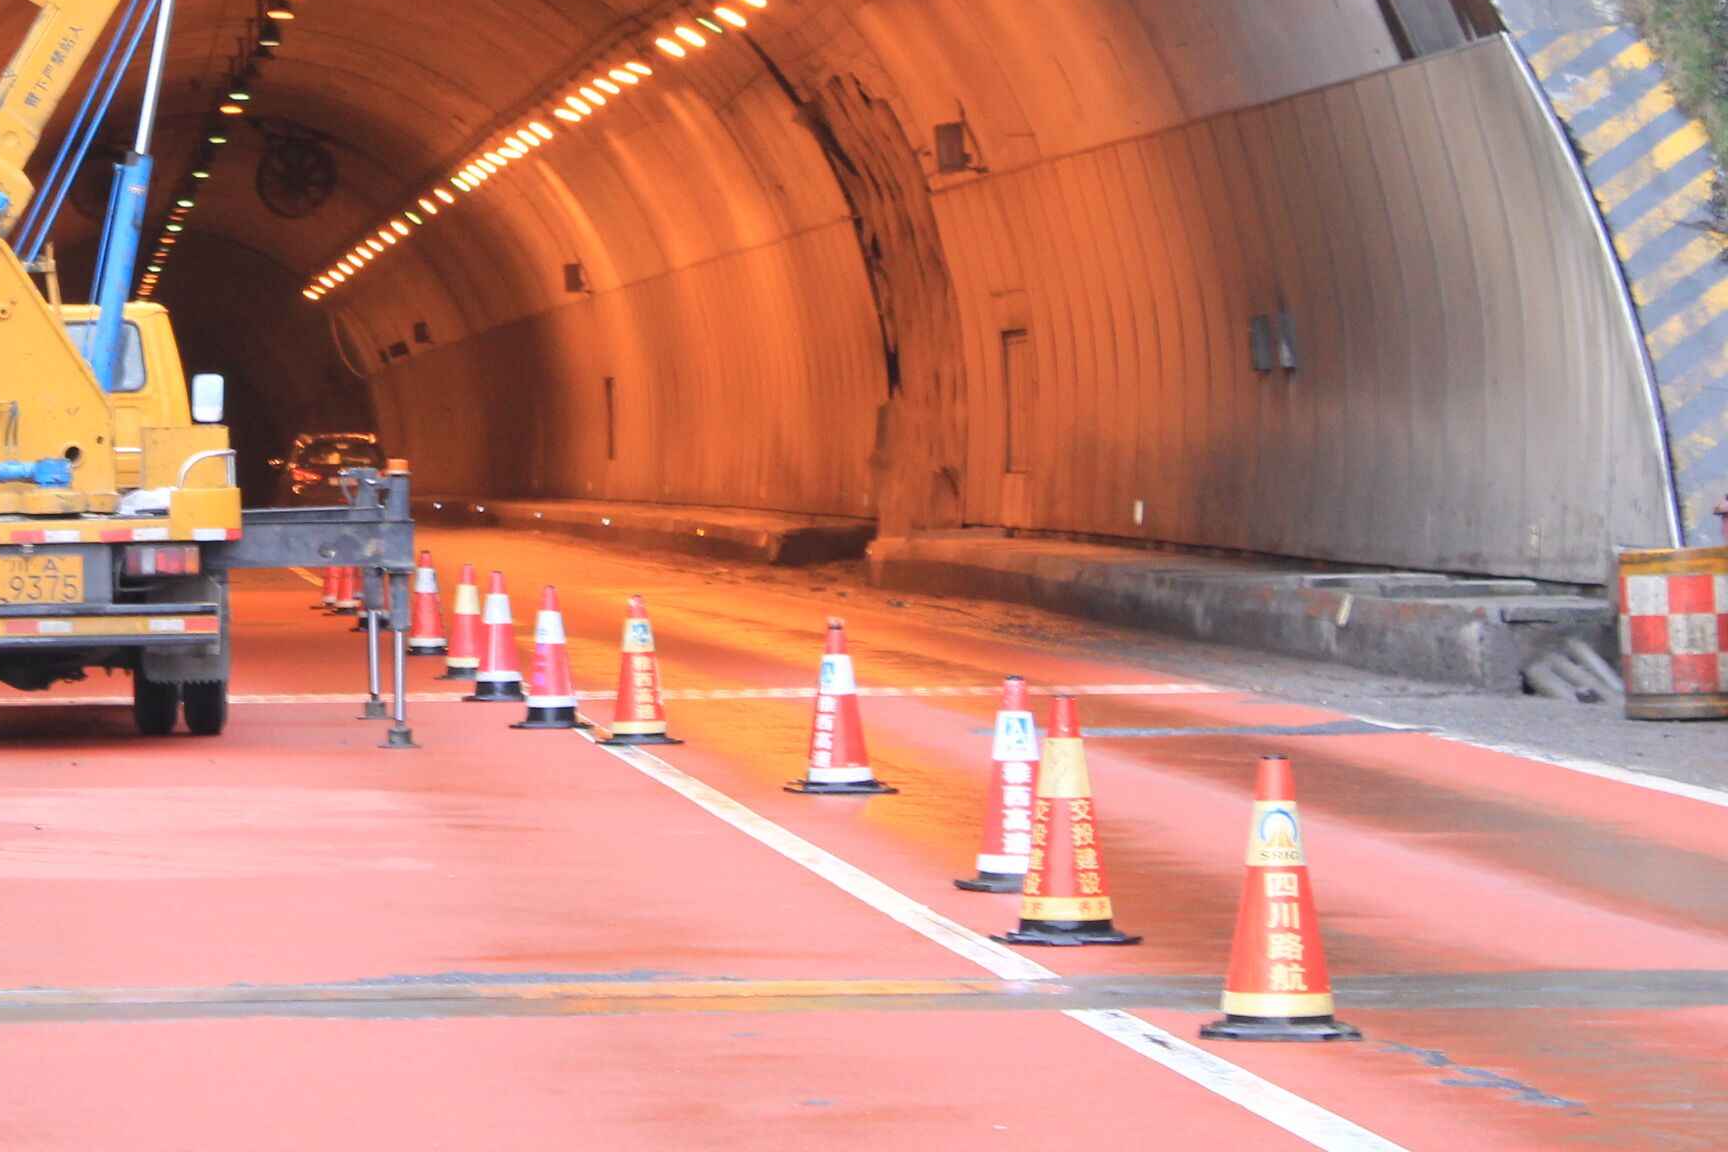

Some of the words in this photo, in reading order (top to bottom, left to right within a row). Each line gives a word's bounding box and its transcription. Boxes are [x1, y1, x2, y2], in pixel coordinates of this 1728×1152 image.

[1068, 798, 1103, 895] 交投建设
[1263, 872, 1309, 992] 四川路航
